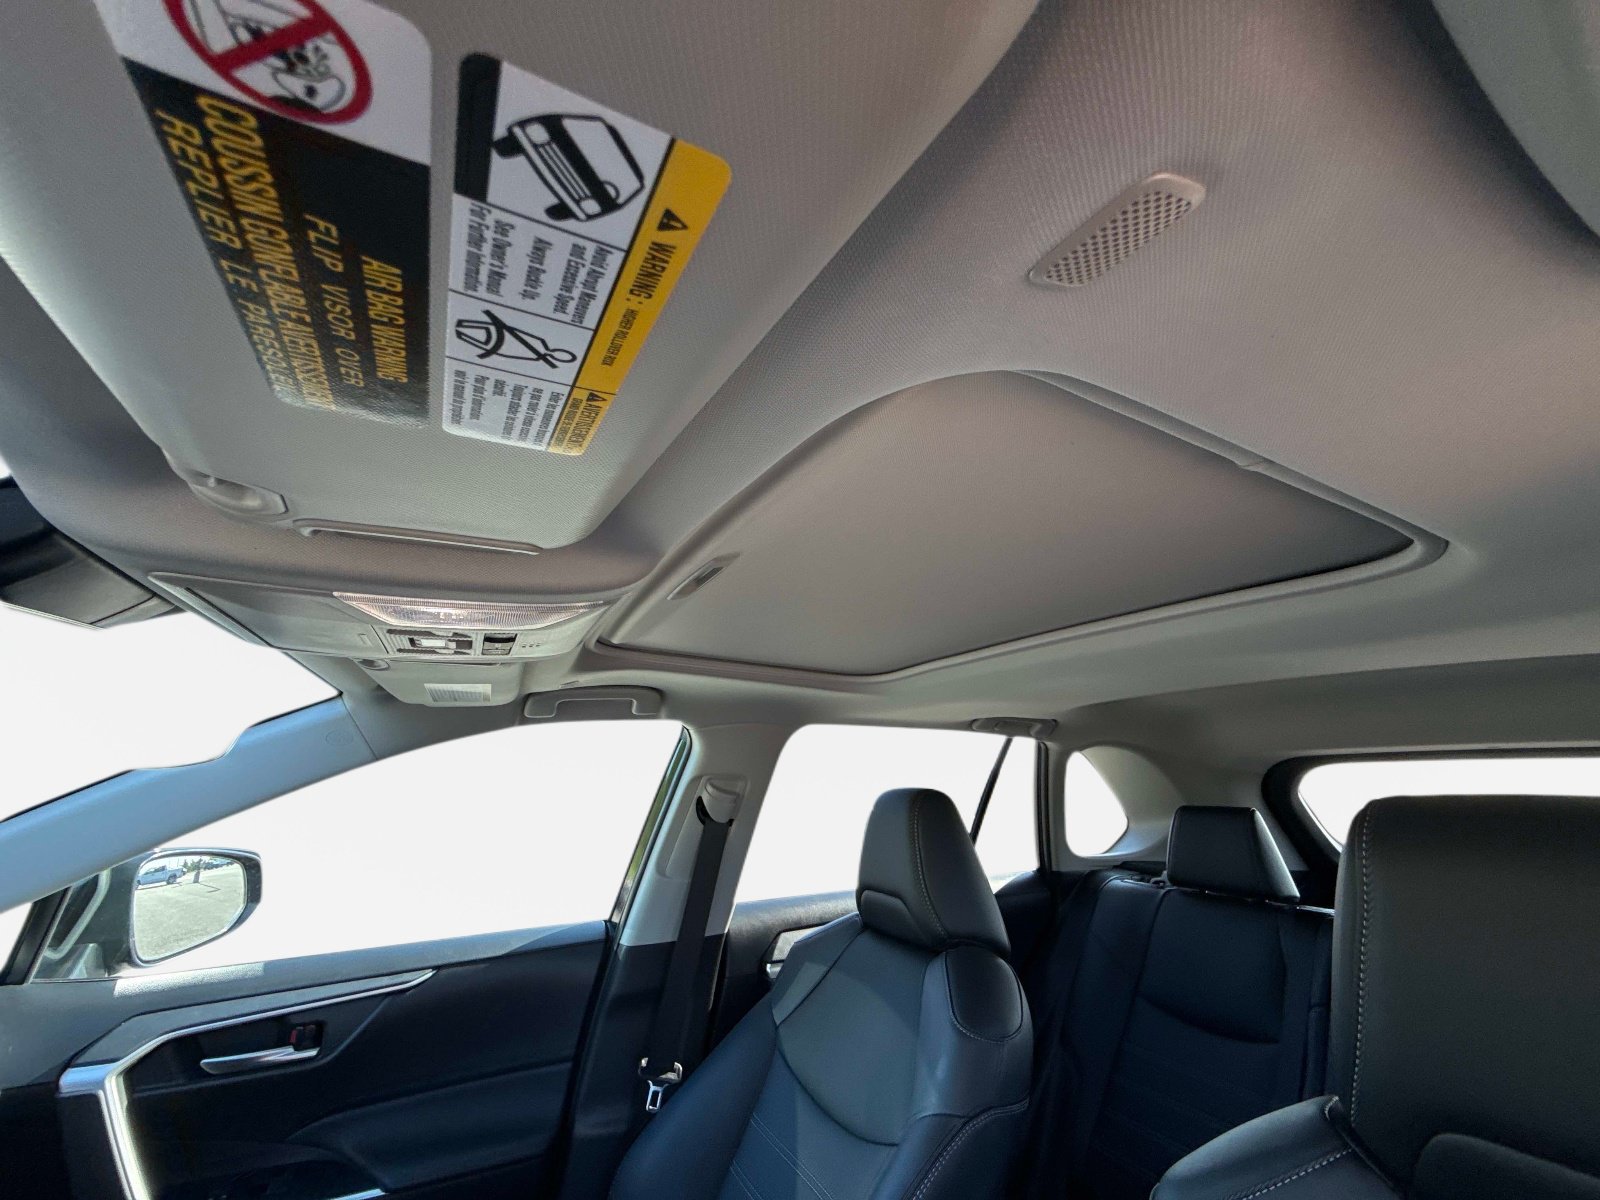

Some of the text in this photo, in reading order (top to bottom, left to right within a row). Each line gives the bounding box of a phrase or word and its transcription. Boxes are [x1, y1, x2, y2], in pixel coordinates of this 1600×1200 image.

[155, 110, 242, 249] REPLIER
[220, 259, 257, 292] LE
[196, 96, 283, 222] COUSSIN
[240, 218, 312, 322] GONFLABLE
[470, 202, 492, 221] For
[467, 219, 490, 251] Further
[526, 236, 555, 266] Always
[486, 219, 516, 298] See Owner's Manual
[569, 243, 587, 261] and
[524, 265, 547, 290] Buckle
[559, 259, 586, 294] Excessive
[571, 245, 614, 324] Avoid Abrupt Maneuvers
[303, 212, 365, 387] FLIP VISOR OVER
[360, 256, 408, 383] AIR BAG WARNING
[619, 308, 639, 331] HIGHER
[606, 329, 631, 356] ROLLOVER
[600, 353, 617, 367] RISK
